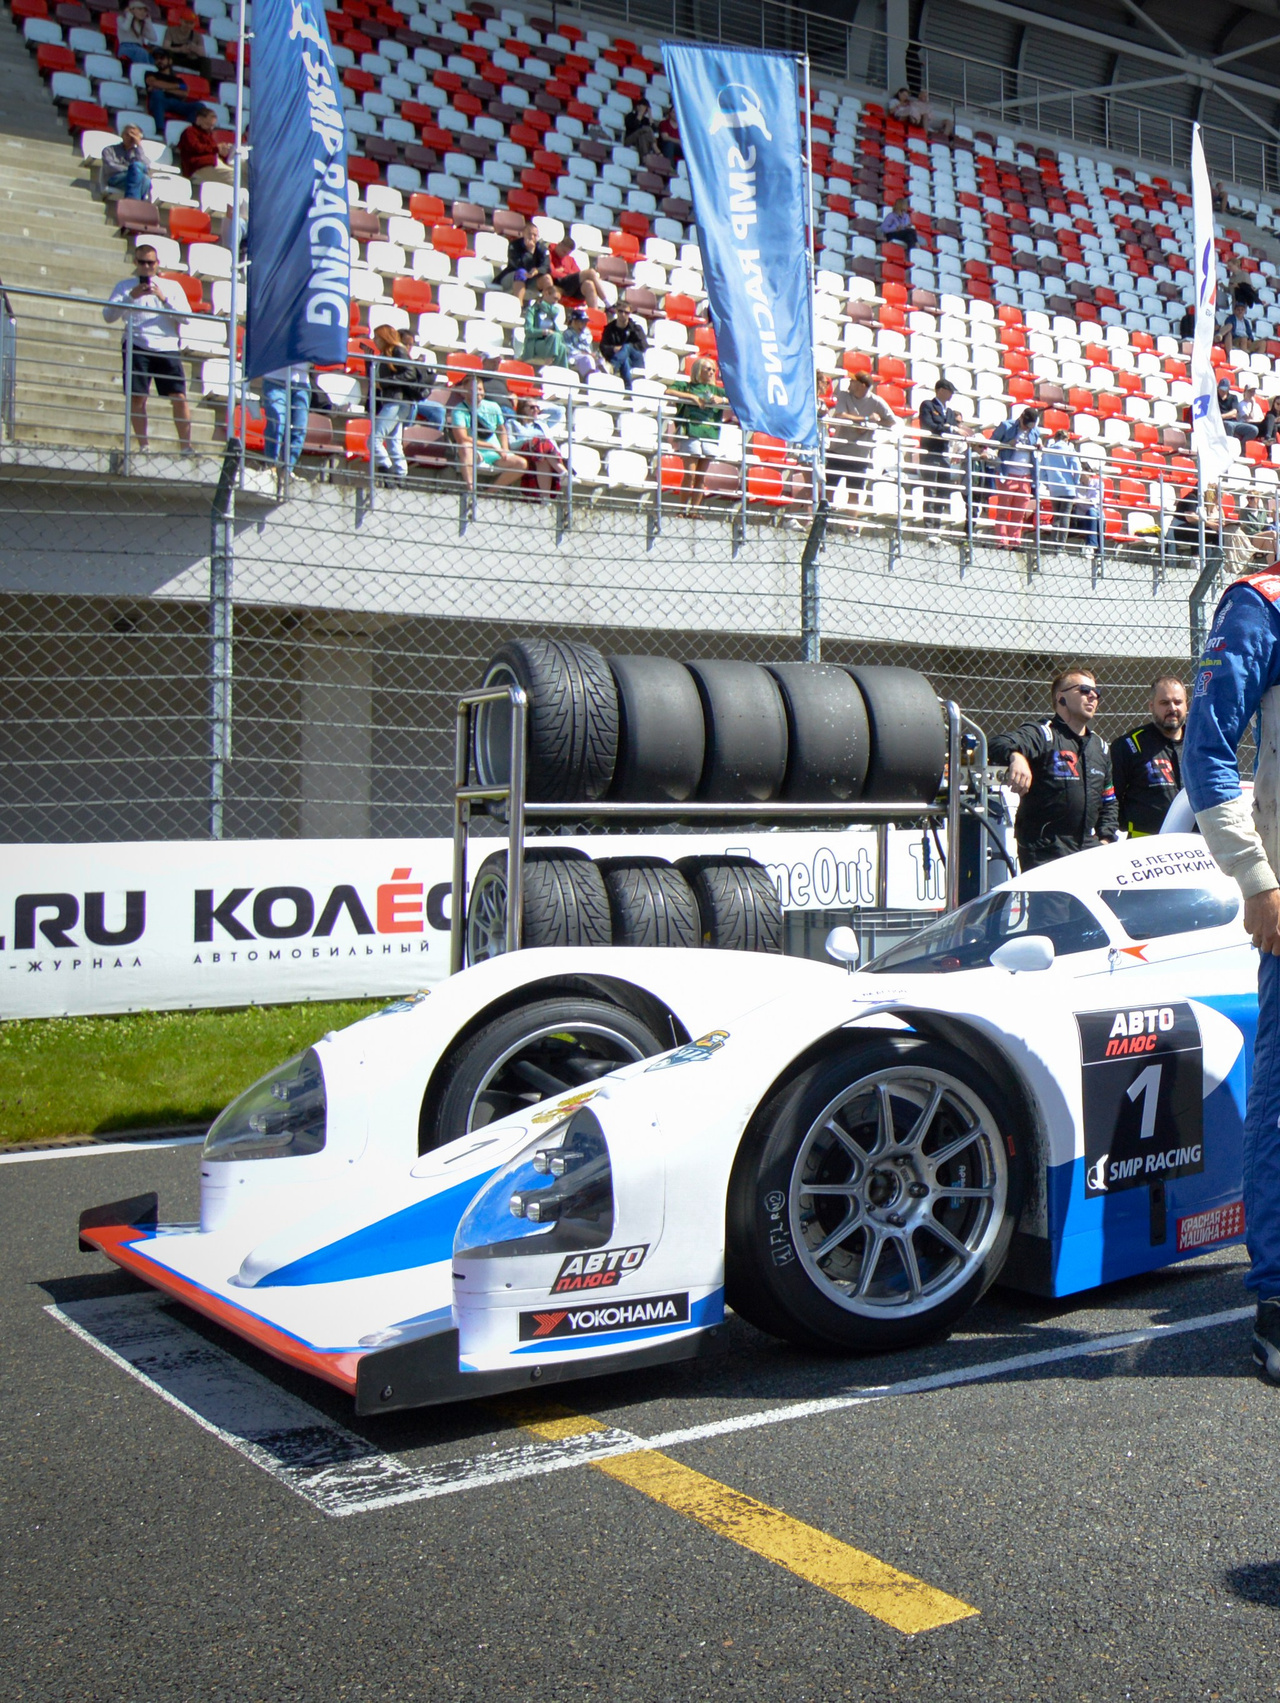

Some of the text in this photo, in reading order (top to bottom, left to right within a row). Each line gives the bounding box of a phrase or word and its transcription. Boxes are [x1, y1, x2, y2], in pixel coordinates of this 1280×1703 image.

[302, 52, 349, 328] SMP RACING
[193, 940, 430, 964] АВТОМОБИЛЬНЫЙ
[1109, 1007, 1175, 1038] АВТО
[1105, 1034, 1157, 1057] ПЛЮС
[1126, 1063, 1163, 1139] 1
[443, 1138, 500, 1165] 1
[1109, 1144, 1202, 1182] SMP RACING
[1181, 1210, 1221, 1233] КРАСНАЯ
[1179, 1226, 1220, 1250] МАШИНА
[561, 1247, 645, 1278] АВТО
[555, 1271, 617, 1292] ПЛЮС
[568, 1300, 678, 1330] YOKOHAMA
